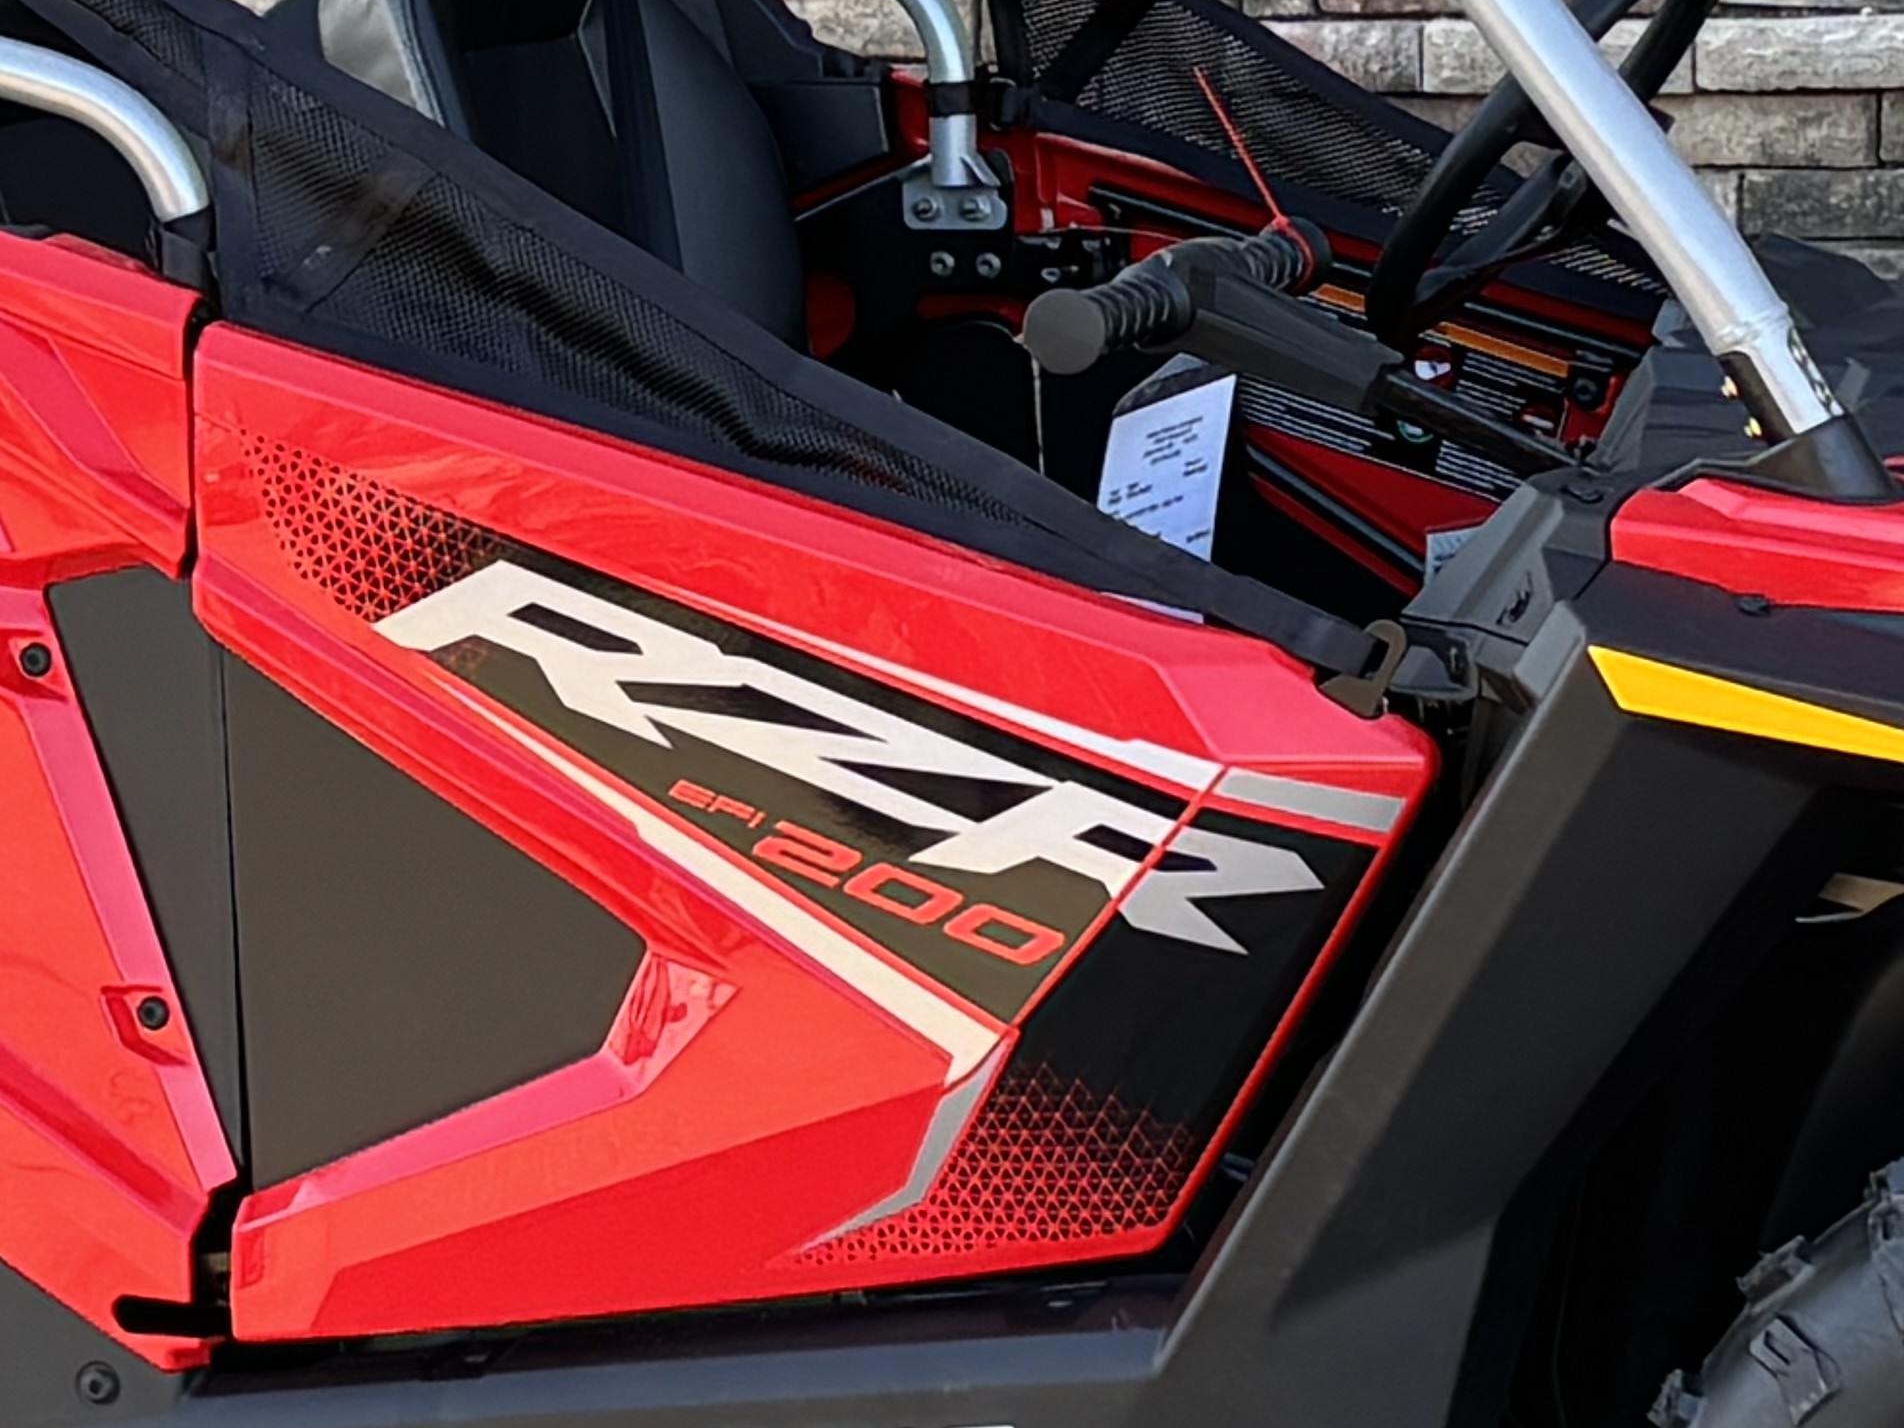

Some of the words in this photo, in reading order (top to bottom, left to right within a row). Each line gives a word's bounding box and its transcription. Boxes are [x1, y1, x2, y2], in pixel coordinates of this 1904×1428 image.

[375, 560, 1324, 955] RZR
[668, 779, 766, 829] EFI
[752, 820, 1066, 965] 200
